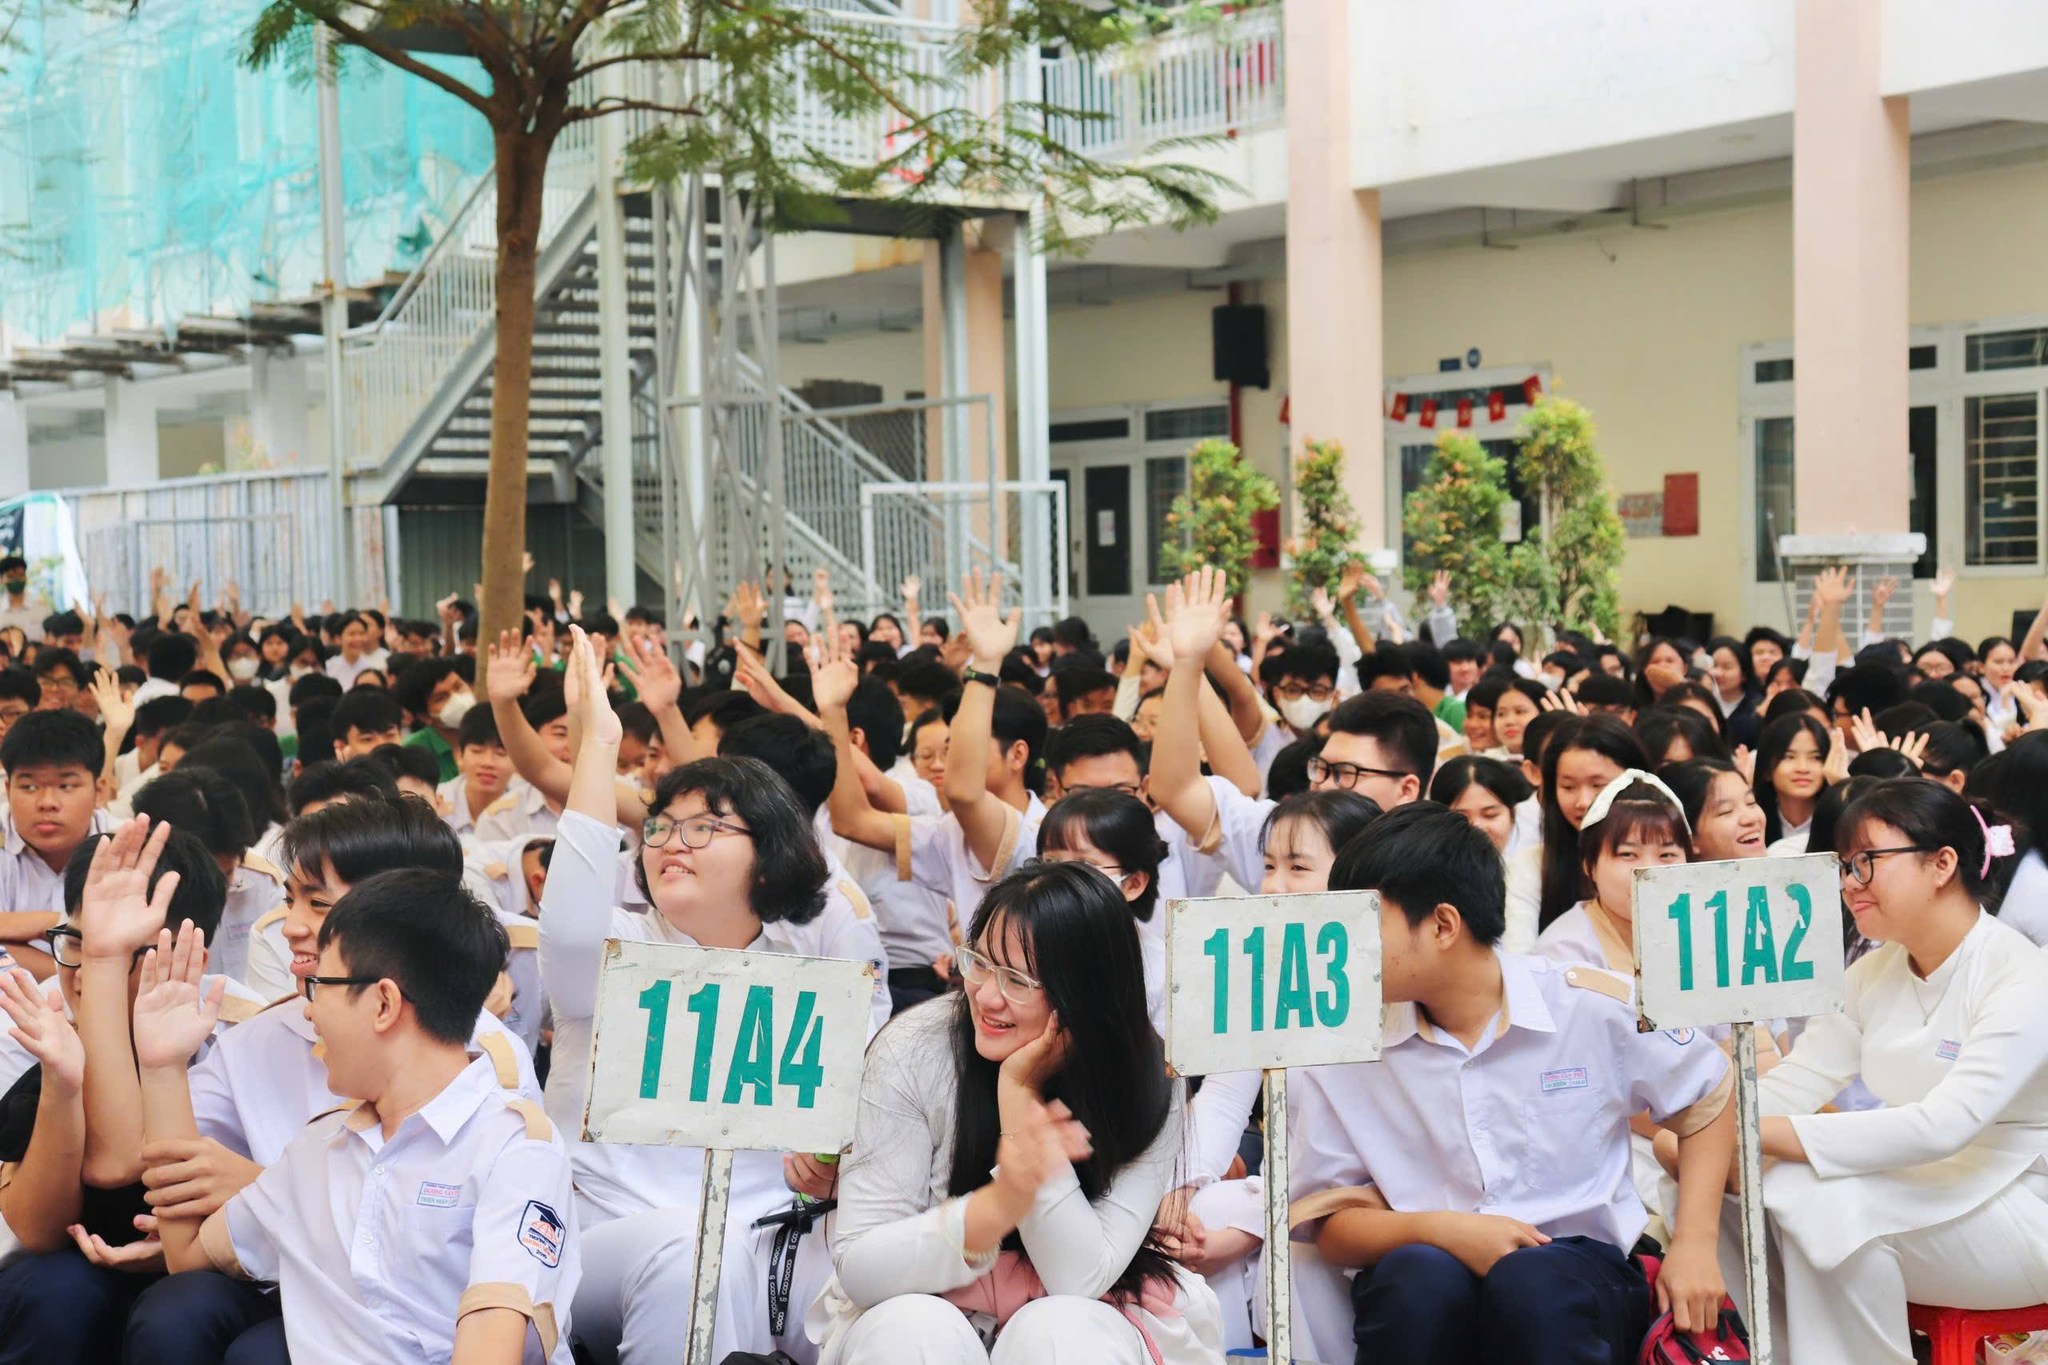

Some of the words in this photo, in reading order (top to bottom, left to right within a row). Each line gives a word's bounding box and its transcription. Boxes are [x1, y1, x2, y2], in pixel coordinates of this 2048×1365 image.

[1204, 921, 1350, 1034] 11A3
[1669, 885, 1814, 991] 11A2
[639, 979, 824, 1109] 11A4
